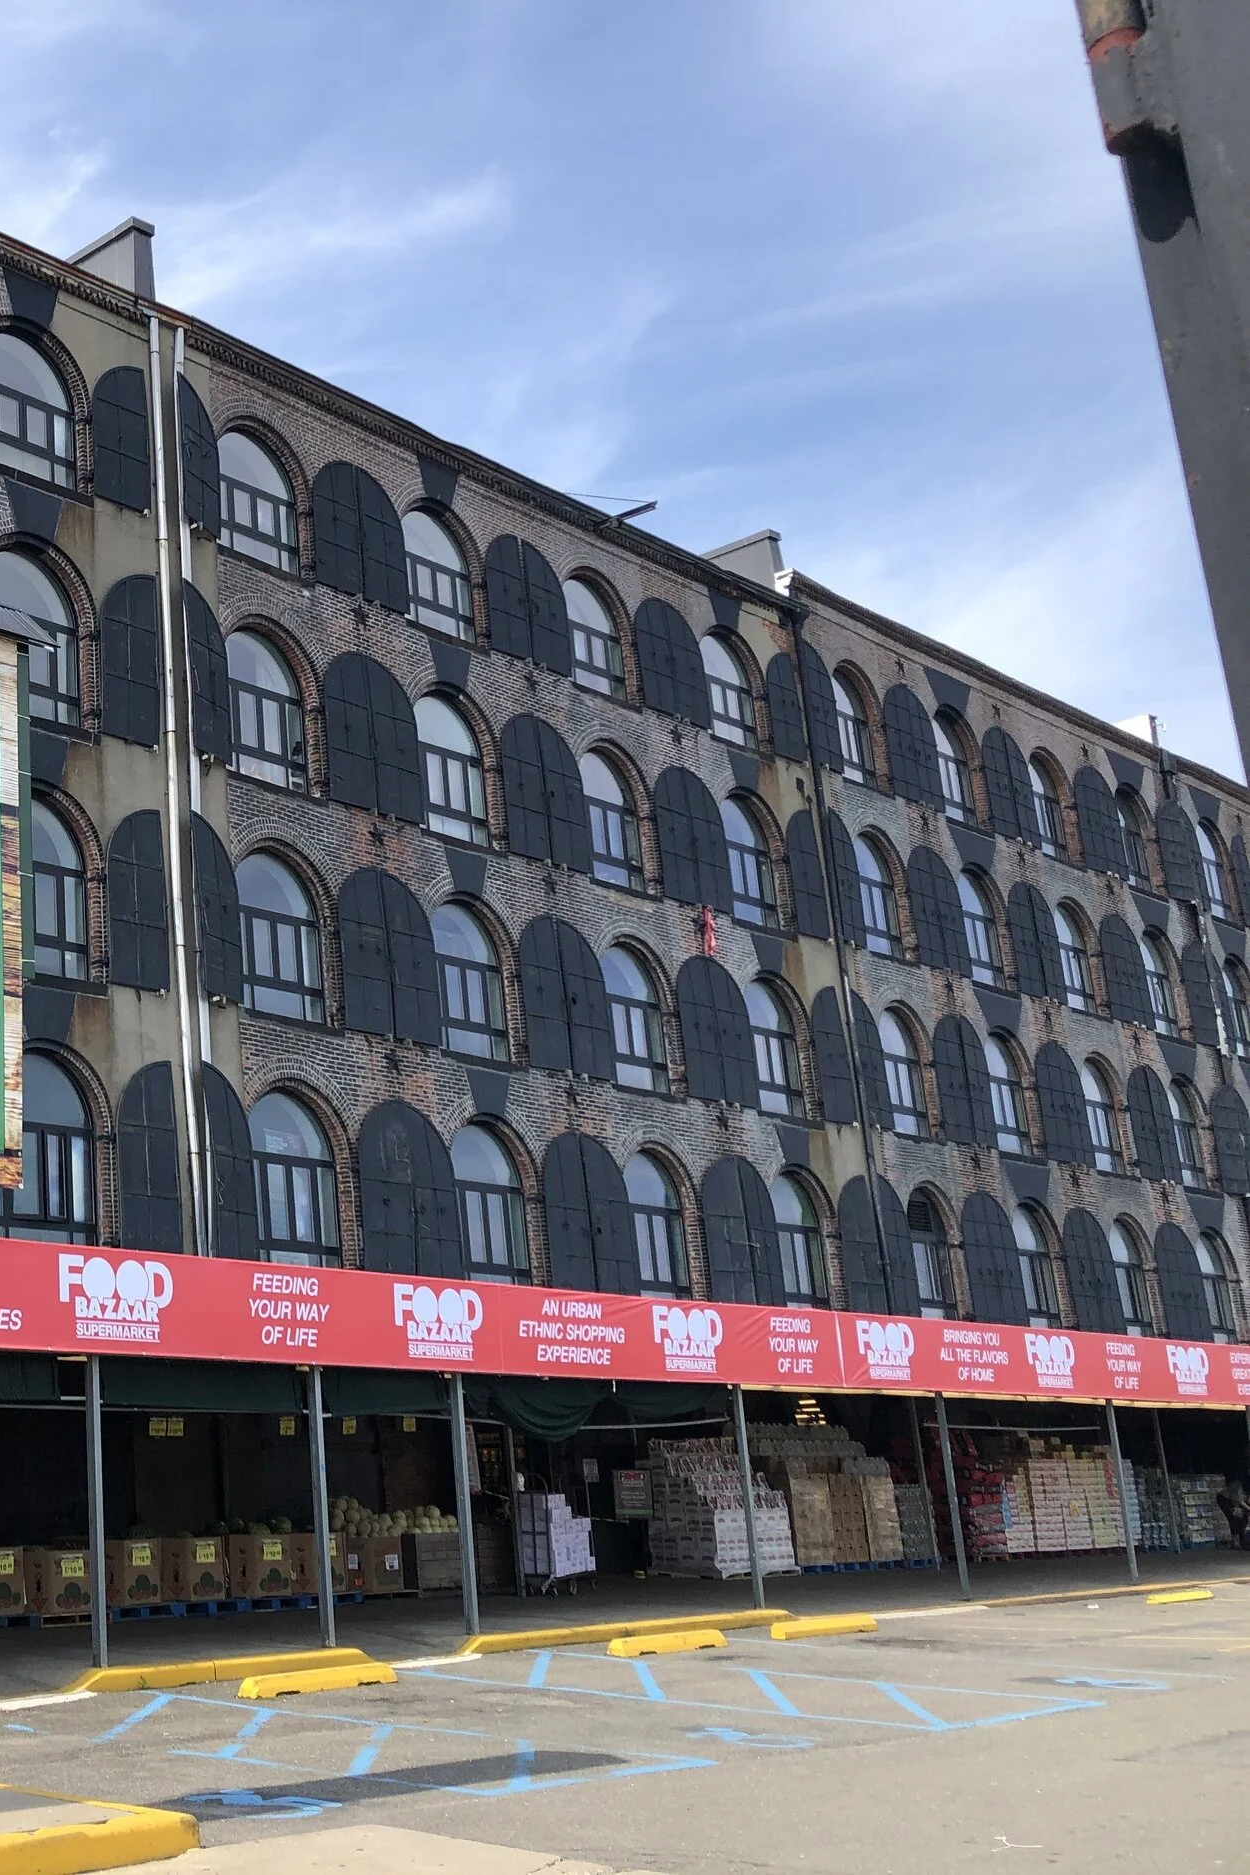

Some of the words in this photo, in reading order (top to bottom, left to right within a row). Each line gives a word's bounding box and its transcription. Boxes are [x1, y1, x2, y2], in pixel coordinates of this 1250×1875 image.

[59, 1253, 173, 1309] FOOD
[253, 1273, 319, 1297] FEEDING
[75, 1296, 160, 1322] BAZAAR
[249, 1298, 292, 1320] YOUR
[295, 1302, 330, 1322] WAY
[393, 1282, 483, 1331] FOOD
[541, 1299, 559, 1317] AN
[561, 1300, 602, 1319] URBAN
[76, 1323, 161, 1340] SUPERMARKET
[407, 1320, 473, 1344] BAZAAR
[519, 1320, 564, 1339] ETHNIC
[566, 1323, 625, 1344] SHOPPING
[652, 1305, 723, 1347] FOOD
[770, 1317, 811, 1334] FEEDING
[261, 1325, 284, 1345] OF
[286, 1327, 319, 1347] LIFE
[856, 1320, 914, 1356] FOOD
[943, 1329, 982, 1345] BRINGING
[983, 1332, 1000, 1346] YOU
[408, 1343, 474, 1359] SUPERMARKET
[537, 1344, 612, 1365] EXPERIENCE
[664, 1338, 716, 1357] BAZAAR
[769, 1338, 796, 1353] YOUR
[797, 1339, 819, 1354] WAY
[1024, 1333, 1075, 1367] FOOD
[1106, 1341, 1136, 1356] FEEDING
[665, 1359, 717, 1371] SUPERMARKET
[778, 1358, 792, 1373] OF
[793, 1359, 813, 1374] LIFE
[867, 1350, 910, 1366] BAZAAR
[940, 1348, 955, 1361] ALL
[956, 1349, 972, 1362] THE
[973, 1349, 1009, 1365] FLAVORS
[1106, 1359, 1126, 1373] YOUR
[1127, 1360, 1142, 1373] WAY
[958, 1367, 969, 1381] OF
[971, 1368, 995, 1382] HOME
